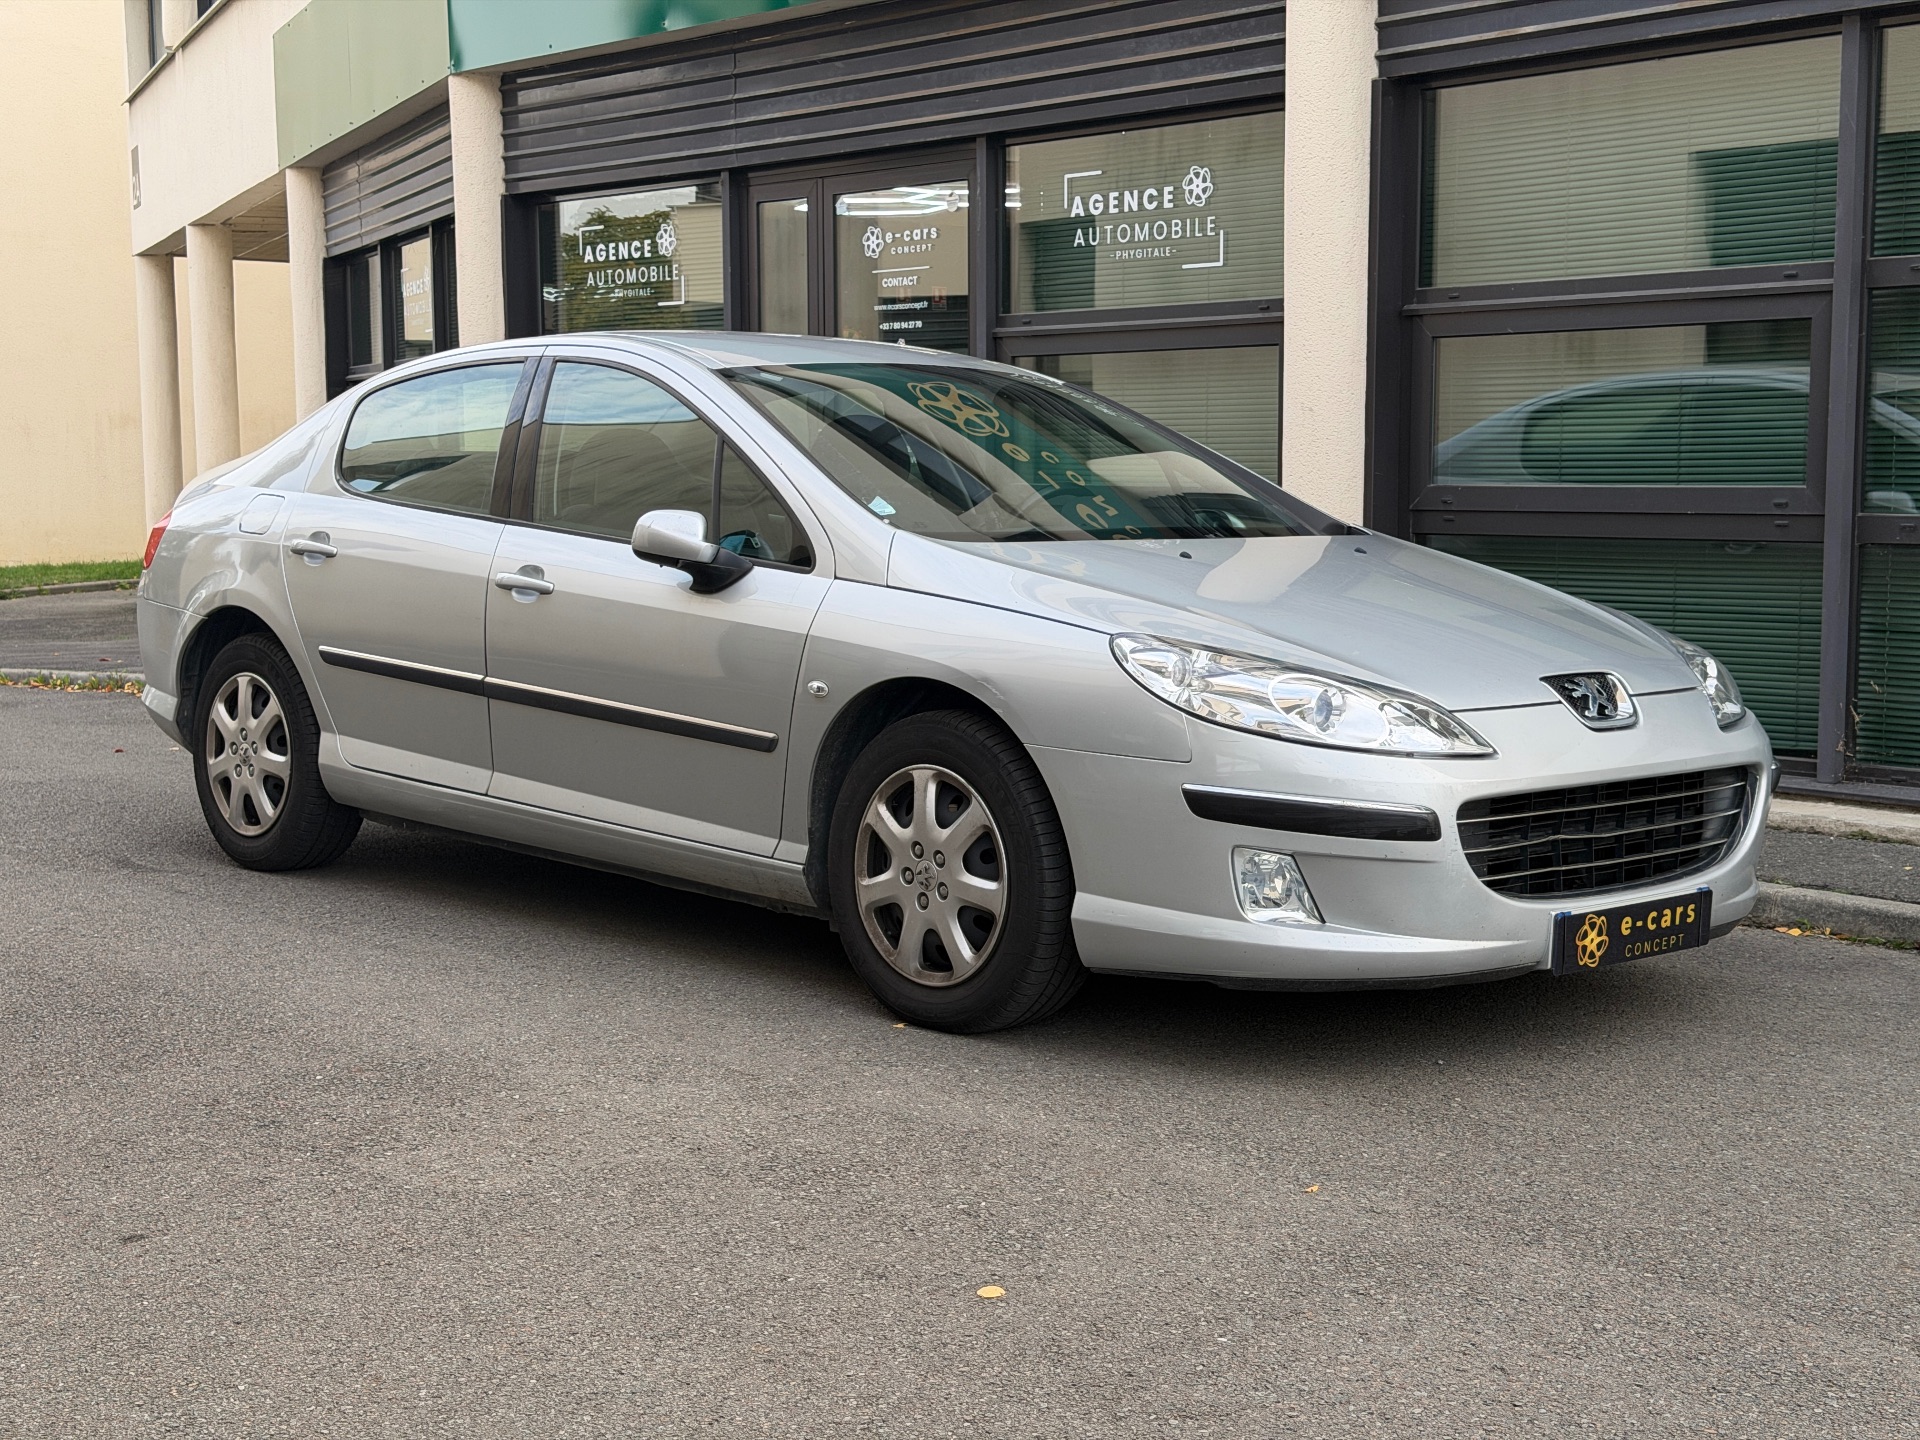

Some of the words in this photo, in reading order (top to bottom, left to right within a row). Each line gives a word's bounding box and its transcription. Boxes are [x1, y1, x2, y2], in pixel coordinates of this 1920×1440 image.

[1070, 186, 1174, 217] AGENCE
[885, 227, 938, 243] e-cars
[1074, 216, 1216, 247] AUTOMOBILE
[583, 239, 652, 263] AGENCE
[890, 243, 932, 255] CONCEPT
[586, 264, 679, 287] AUTOMOBILE
[882, 275, 918, 288] CONTACT
[1620, 903, 1695, 936] e-cars
[1625, 933, 1685, 958] CONCEPT
